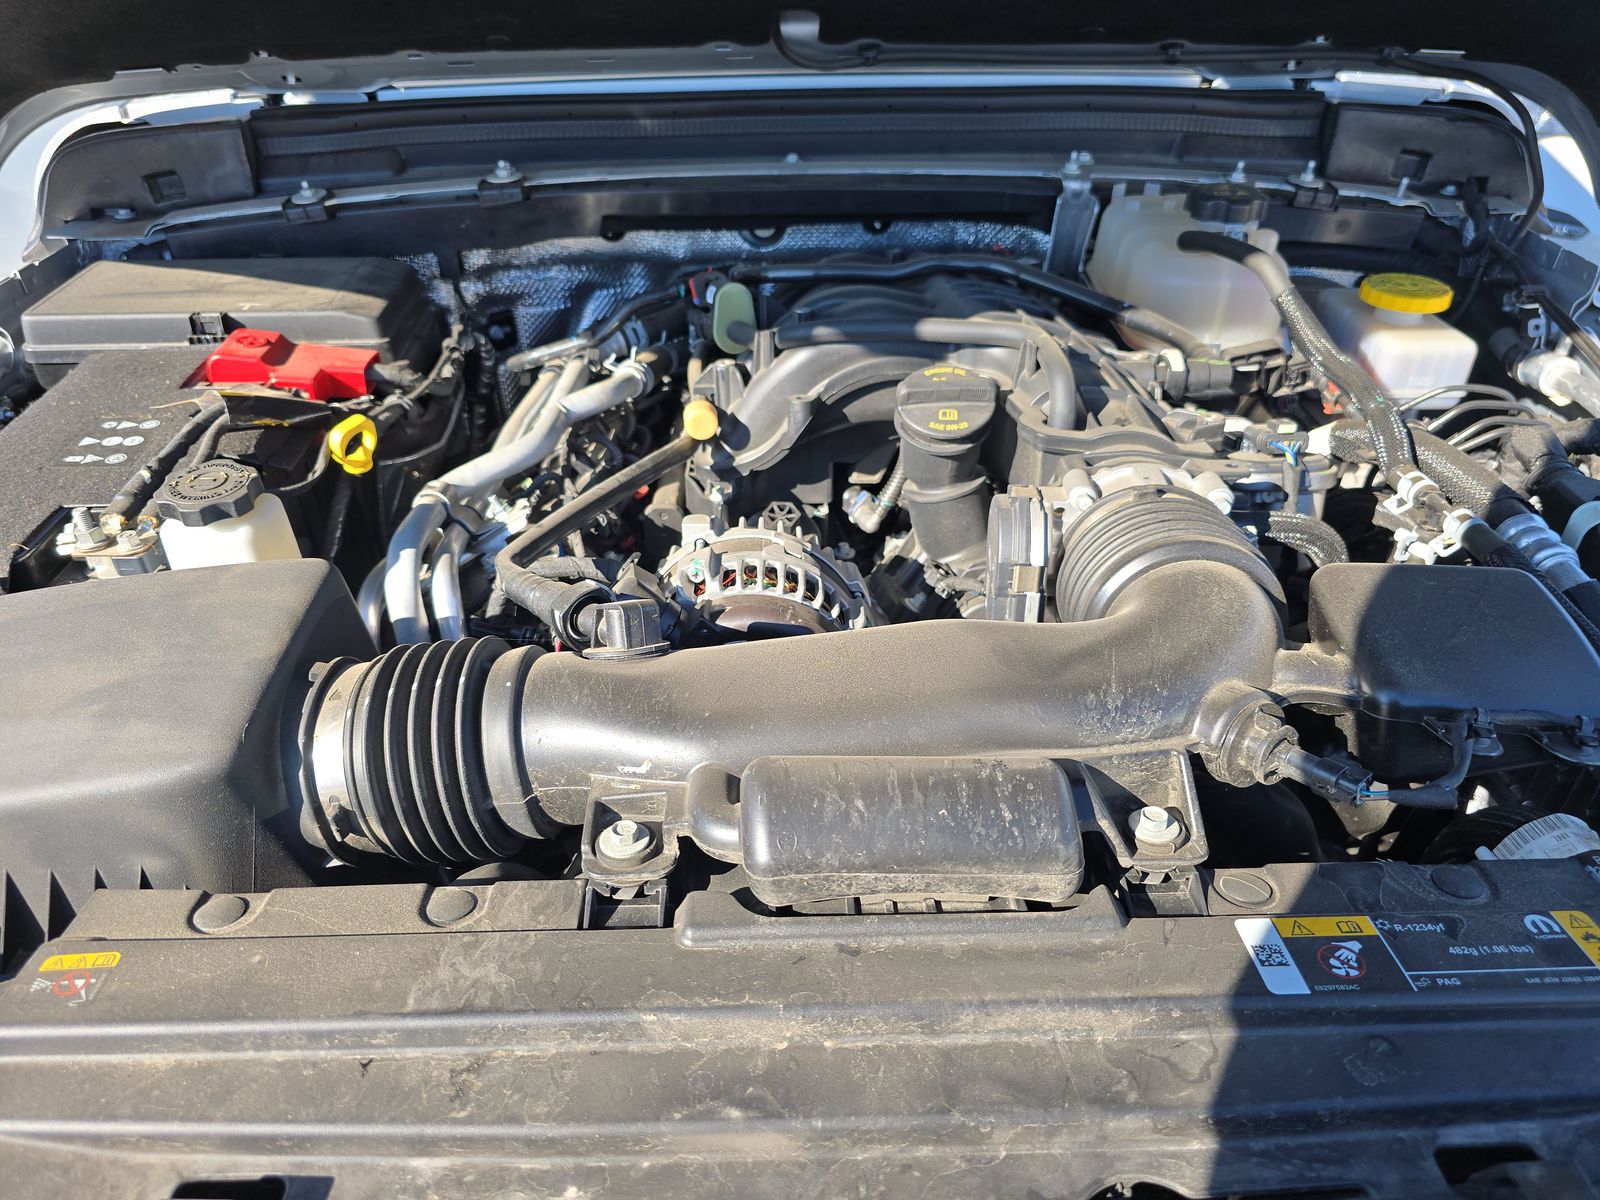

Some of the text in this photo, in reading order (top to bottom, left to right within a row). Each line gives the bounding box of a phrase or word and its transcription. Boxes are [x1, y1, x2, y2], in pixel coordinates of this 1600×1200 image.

[923, 367, 967, 377] ENGINE OIL
[928, 421, 945, 431] SAE
[1393, 922, 1446, 933] R-1234yf
[1436, 977, 1461, 986] PAG
